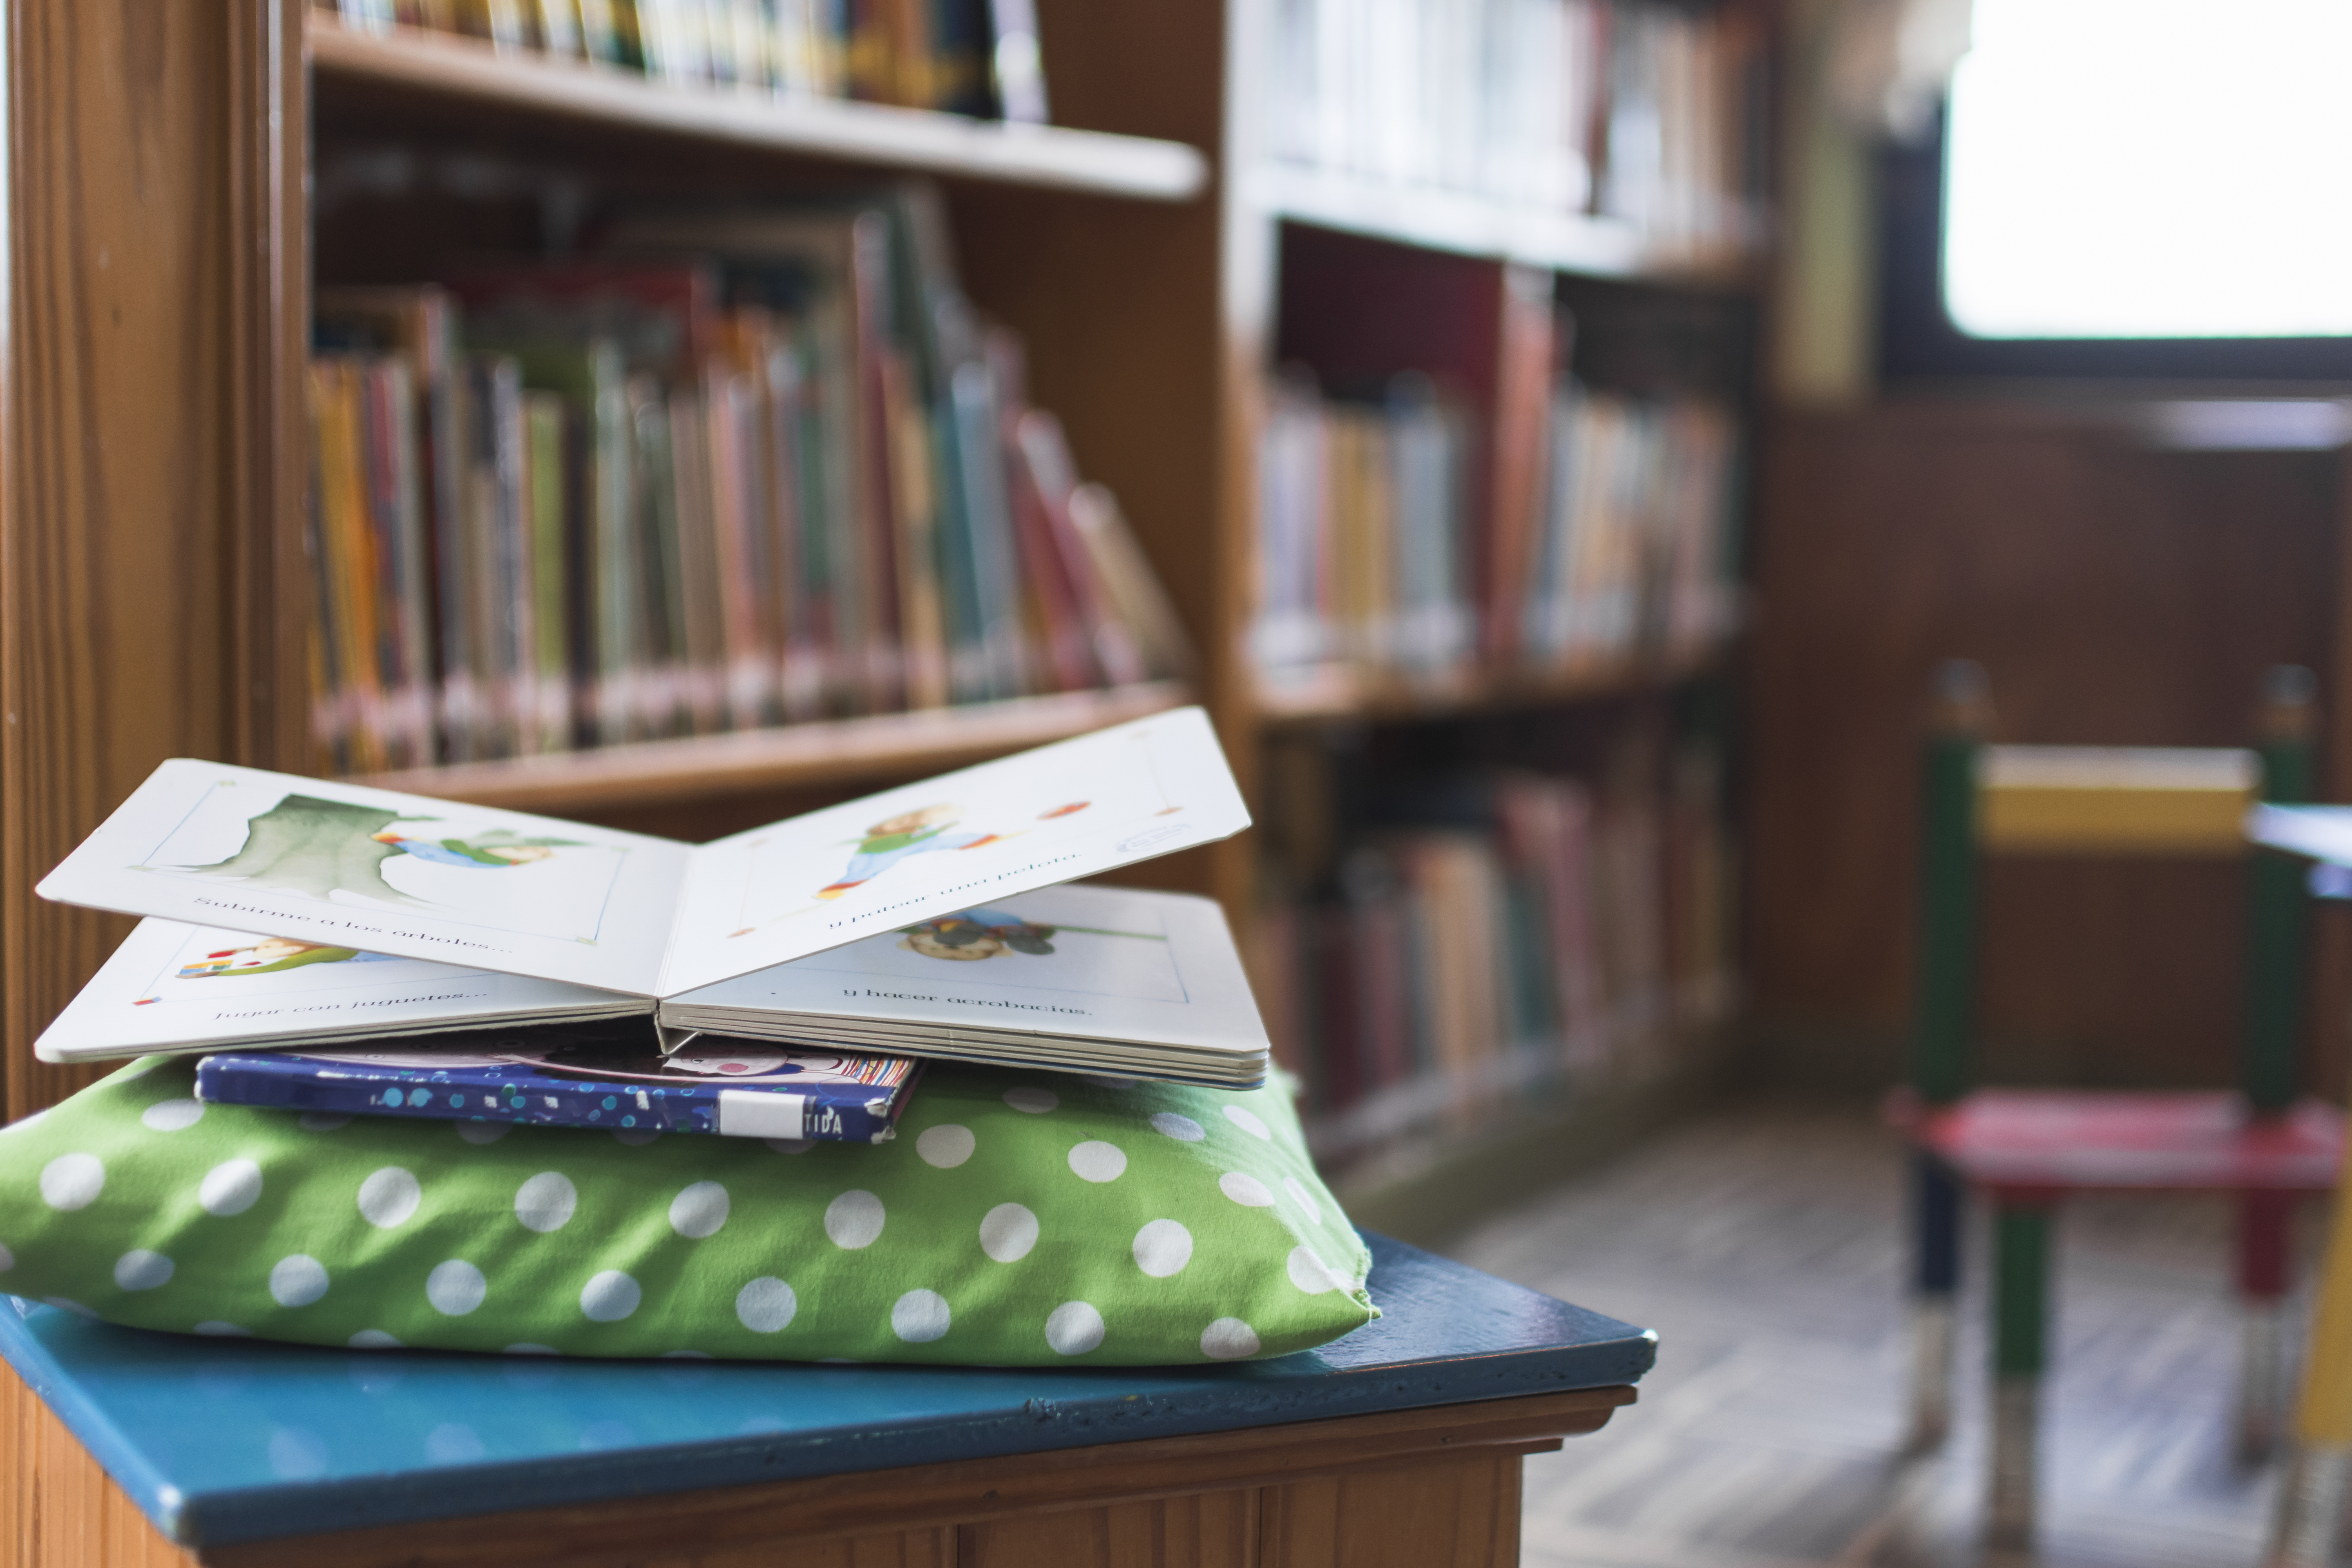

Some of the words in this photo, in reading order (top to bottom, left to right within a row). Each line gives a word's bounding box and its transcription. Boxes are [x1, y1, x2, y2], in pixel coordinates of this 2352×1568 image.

[829, 921, 842, 929] y
[851, 895, 929, 923] patear
[940, 879, 987, 895] una
[997, 854, 1081, 881] pelota.
[194, 898, 310, 921] Subirme
[344, 922, 382, 933] los
[393, 931, 512, 953] árboles...
[214, 1010, 284, 1019] Jugar
[350, 993, 487, 1009] juguetes...
[843, 989, 858, 997] y
[865, 989, 938, 1001] hacer
[947, 998, 1092, 1015] acrobacias.
